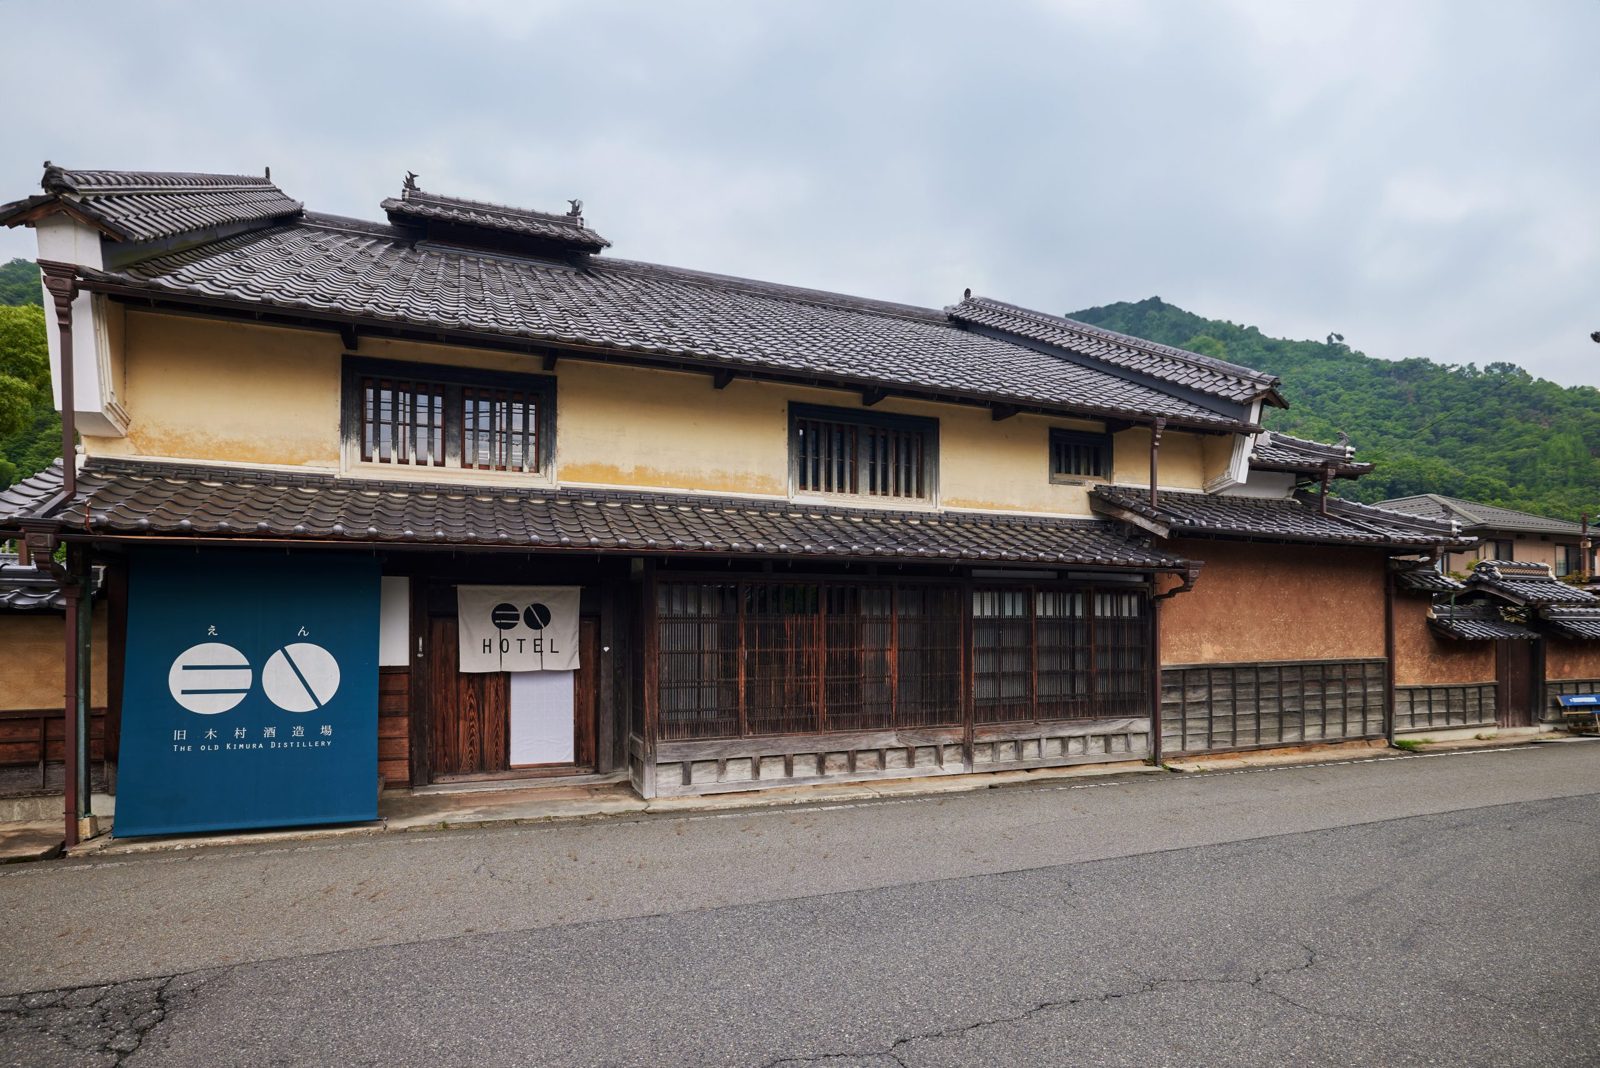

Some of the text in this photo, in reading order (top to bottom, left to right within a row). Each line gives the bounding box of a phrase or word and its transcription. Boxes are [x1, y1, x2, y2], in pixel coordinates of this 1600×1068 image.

[482, 638, 559, 653] HOTEL
[173, 725, 332, 741] 旧木村酒造場
